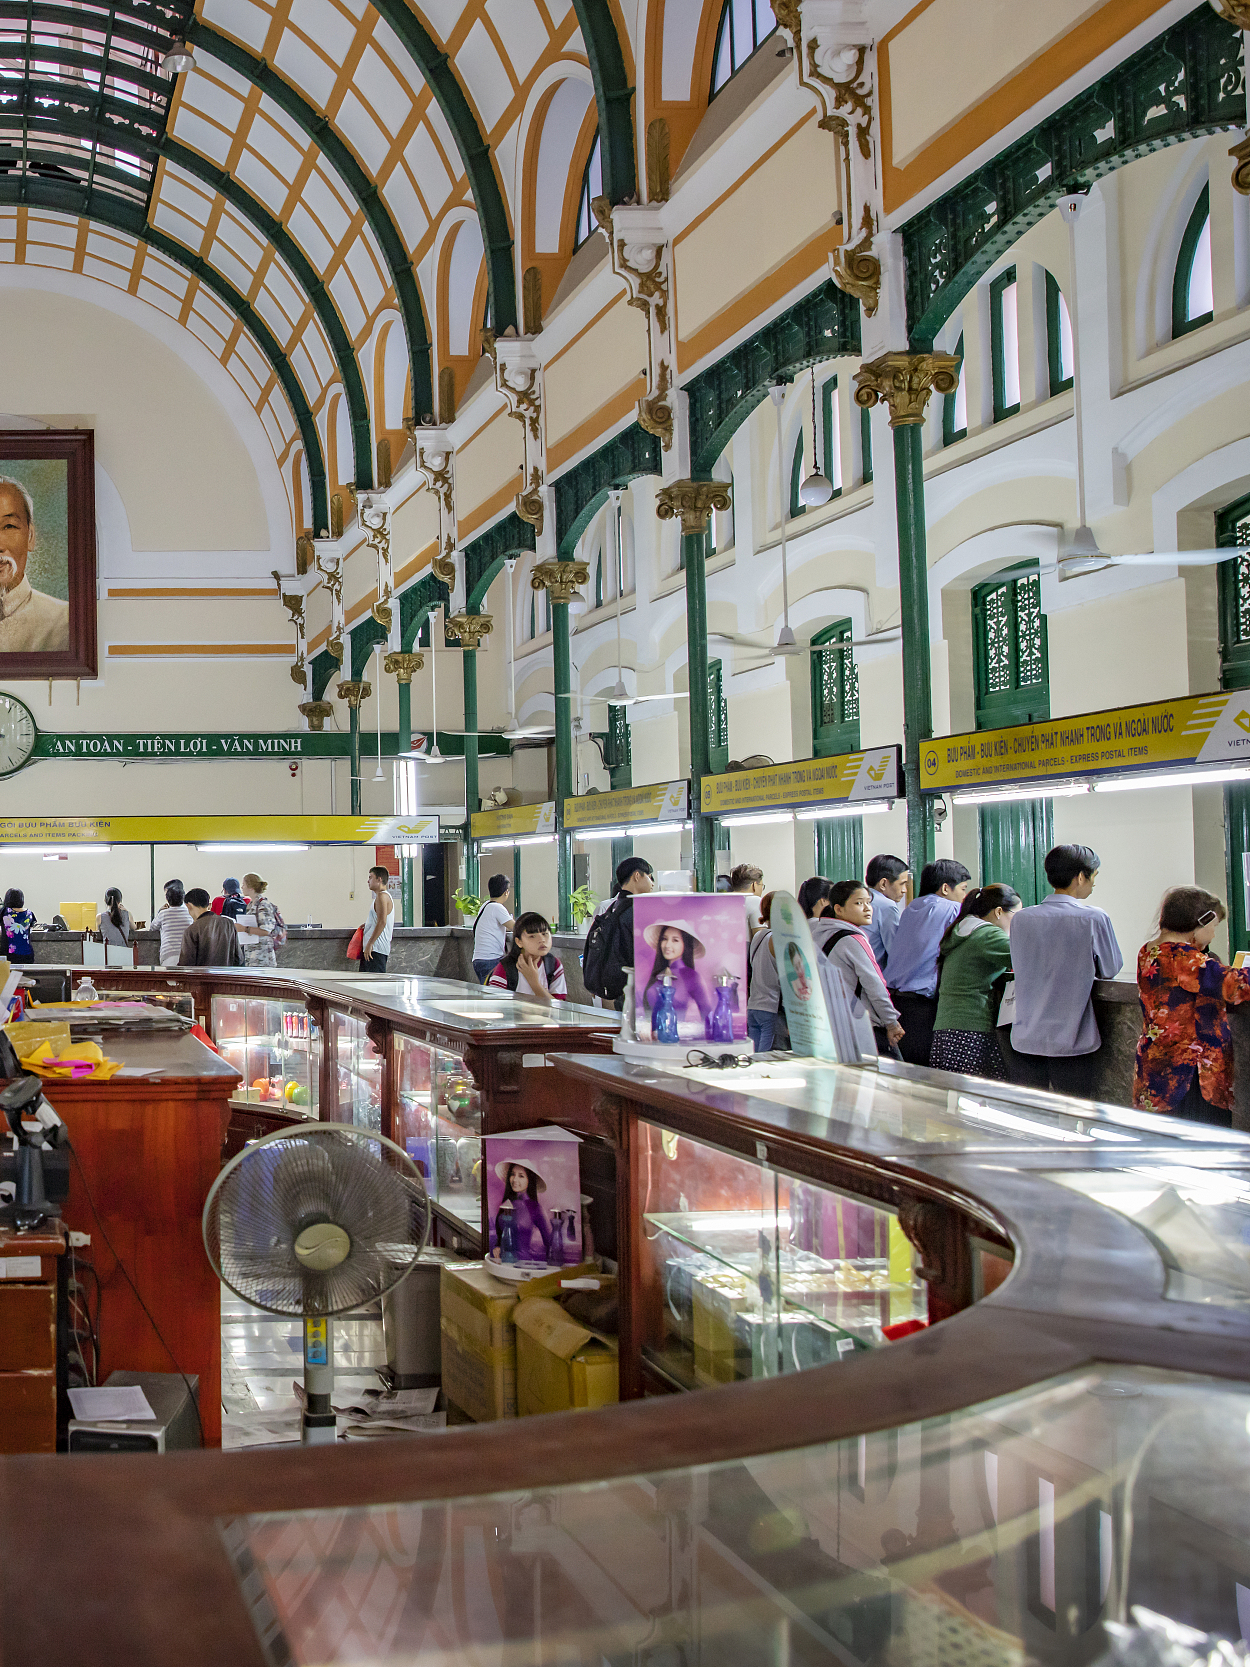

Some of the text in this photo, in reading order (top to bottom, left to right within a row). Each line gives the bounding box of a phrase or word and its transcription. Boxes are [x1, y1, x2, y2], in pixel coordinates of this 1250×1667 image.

[1060, 728, 1084, 747] NHANH
[1086, 723, 1110, 743] TRONG
[1113, 716, 1123, 740] VÀ
[1125, 713, 1149, 738] NGOÀI
[1151, 709, 1174, 735] NƯỚC
[54, 740, 76, 752] AN
[80, 736, 123, 752] TOÀN
[137, 736, 176, 755] TIỆN
[180, 738, 207, 755] LỢI
[220, 736, 253, 751] VĂN
[258, 738, 302, 752] MINH
[927, 758, 936, 768] 04
[955, 746, 1148, 778] DOMESTIC AND INTERNATIONAL PARCELS EXPRESS POSTAL ITEMS
[18, 821, 37, 829] BƯU
[68, 820, 87, 828] BƯU
